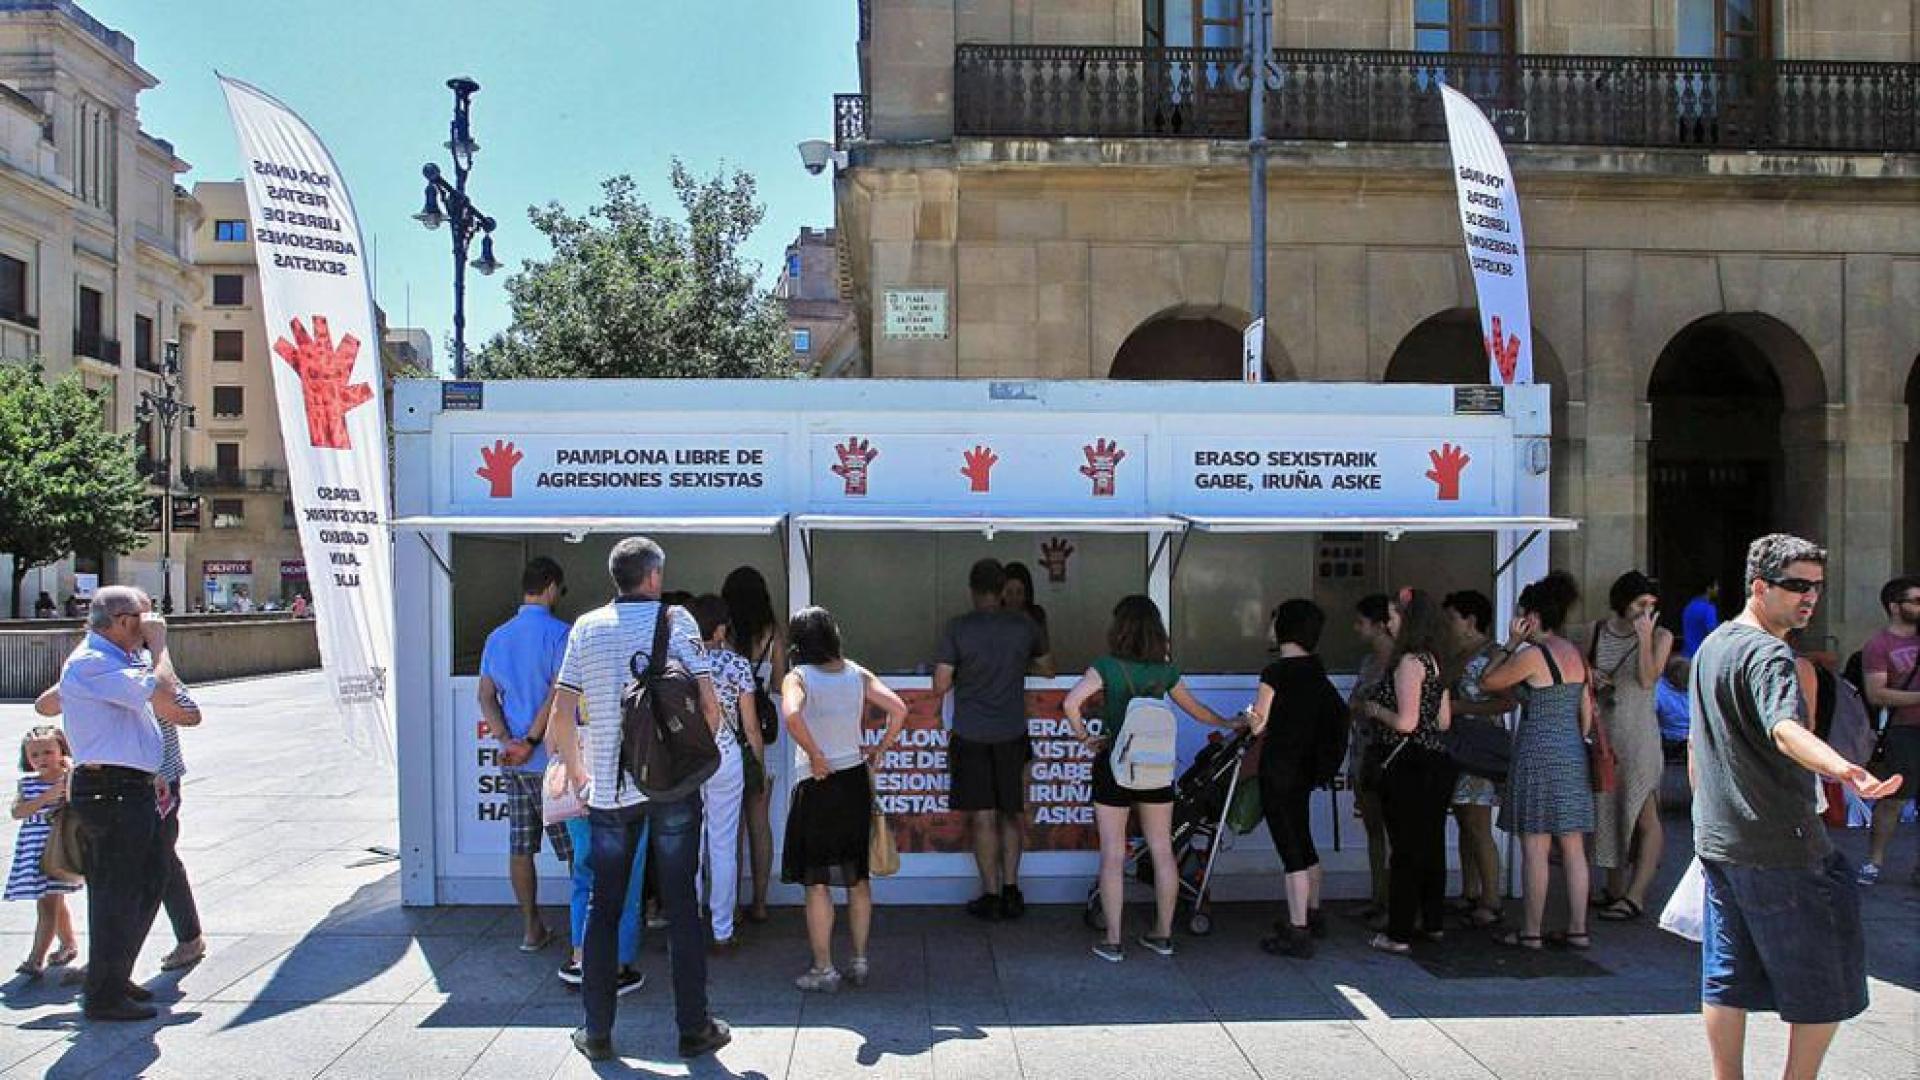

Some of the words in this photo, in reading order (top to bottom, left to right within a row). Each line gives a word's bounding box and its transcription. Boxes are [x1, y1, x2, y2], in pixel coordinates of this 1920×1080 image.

[556, 449, 668, 465] PAMPLONA
[675, 449, 730, 465] LIBRE
[736, 449, 763, 465] DE
[1194, 451, 1260, 467] ERASO
[1267, 451, 1377, 467] SEXISTARIK
[536, 472, 662, 488] AGRESIONES
[669, 472, 763, 488] SEXISTAS
[1194, 474, 1254, 491] GABE,
[1262, 469, 1323, 489] IRUÑA
[1331, 474, 1382, 489] ASKE
[1028, 719, 1102, 736] ERAO
[917, 751, 948, 769] DE
[1031, 762, 1092, 780] GABE
[873, 795, 951, 813] XISTAS
[1034, 806, 1094, 823] ASKE
